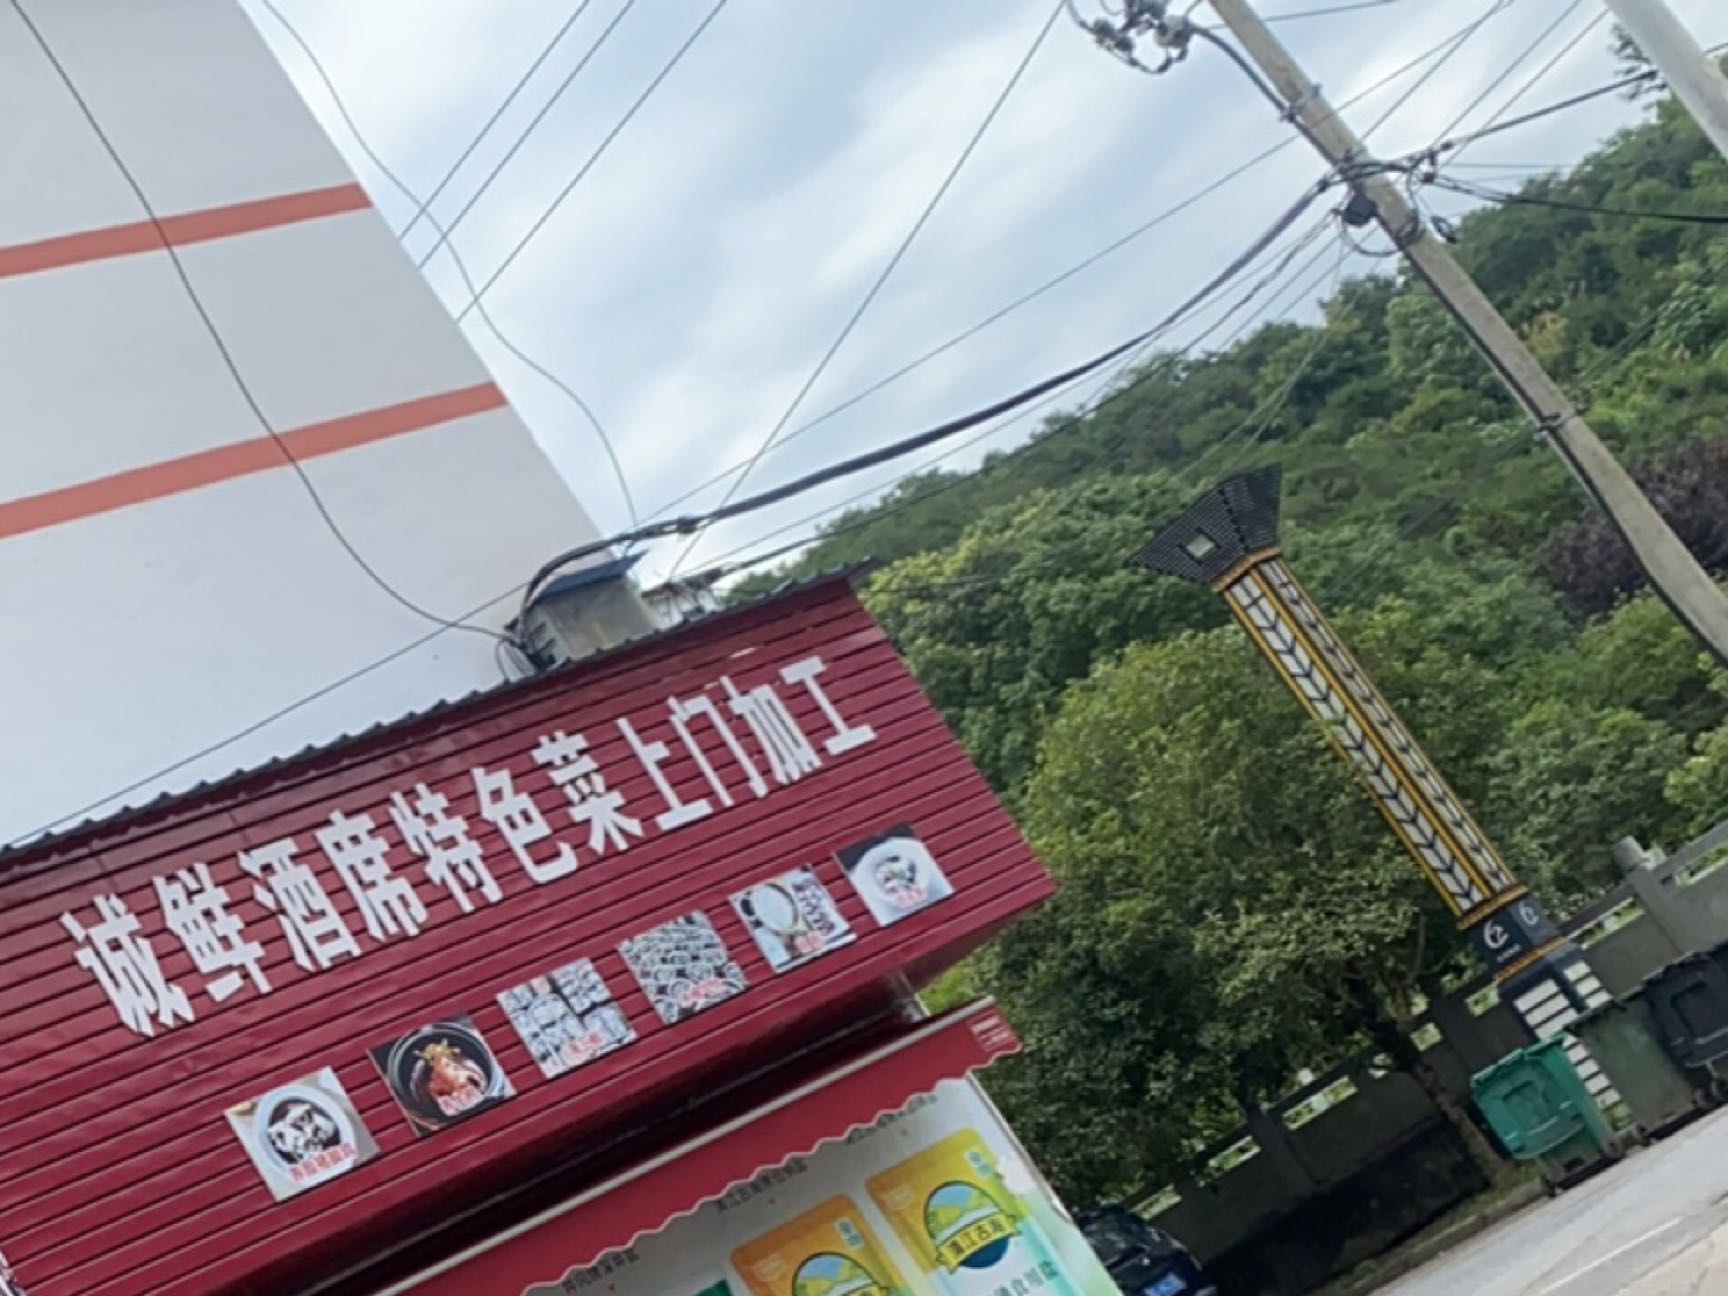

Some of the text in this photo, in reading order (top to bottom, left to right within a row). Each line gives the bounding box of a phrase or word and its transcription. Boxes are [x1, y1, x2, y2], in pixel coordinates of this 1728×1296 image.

[60, 654, 877, 1037] 诚鲜酒席特色菜上门加工
